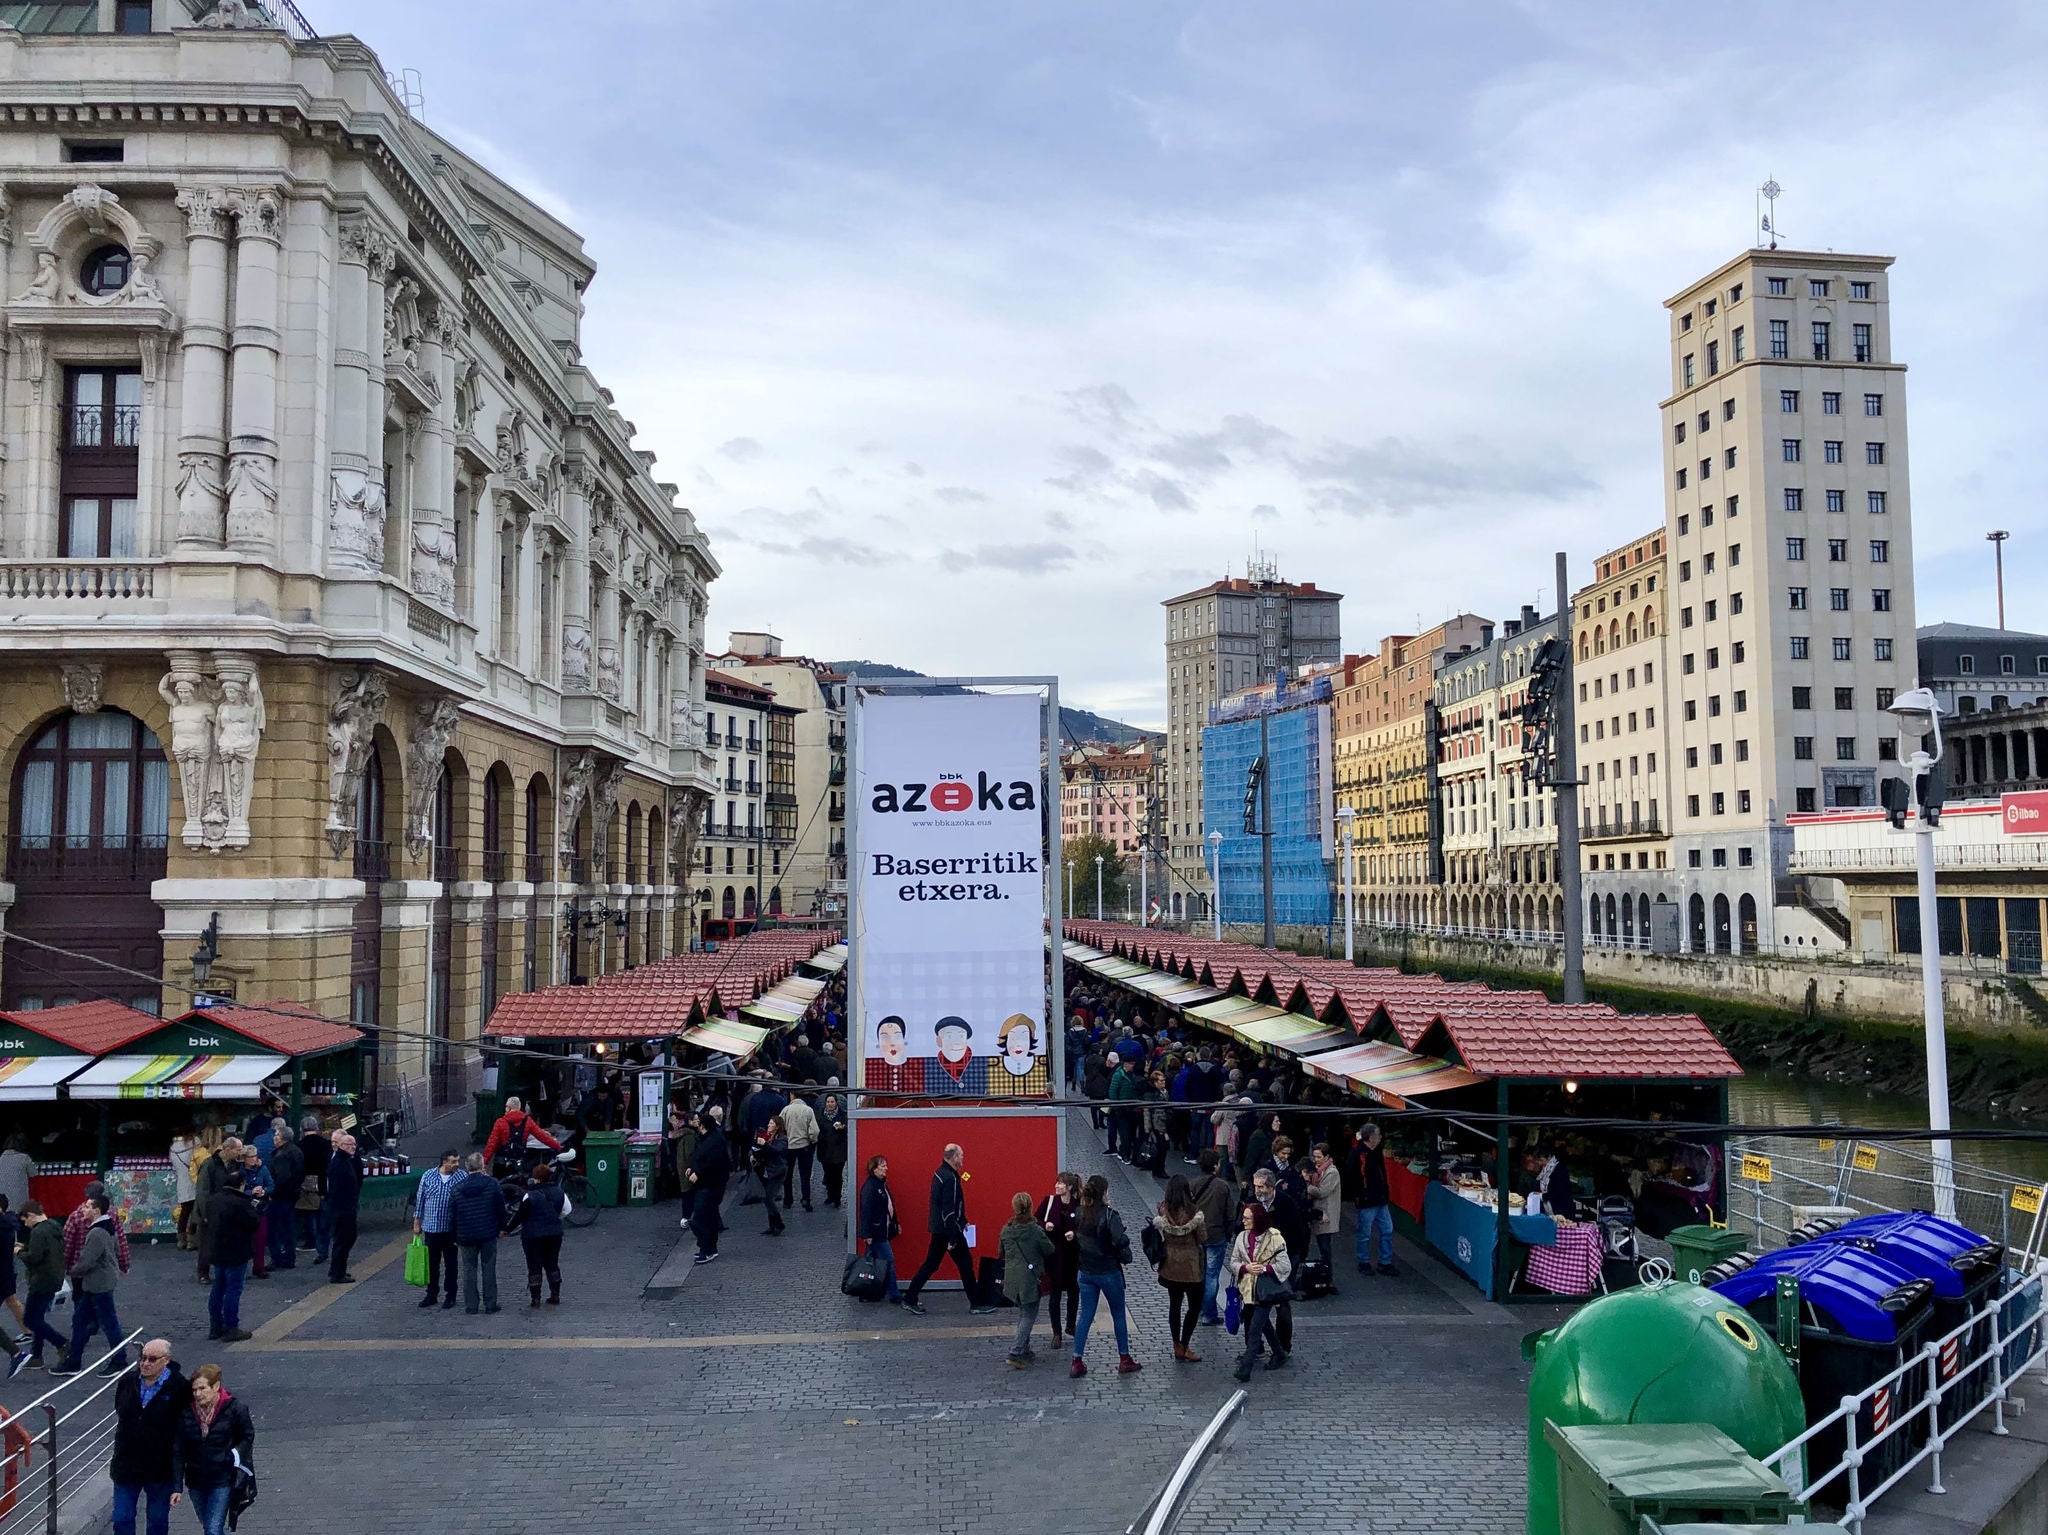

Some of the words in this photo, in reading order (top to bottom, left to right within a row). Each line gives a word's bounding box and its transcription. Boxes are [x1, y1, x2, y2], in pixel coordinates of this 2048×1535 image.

[872, 771, 1035, 813] azoka
[2007, 804, 2040, 824] Bilbao
[872, 852, 1038, 876] Baserritik
[898, 880, 1010, 901] etxera.
[189, 1037, 220, 1047] bbk
